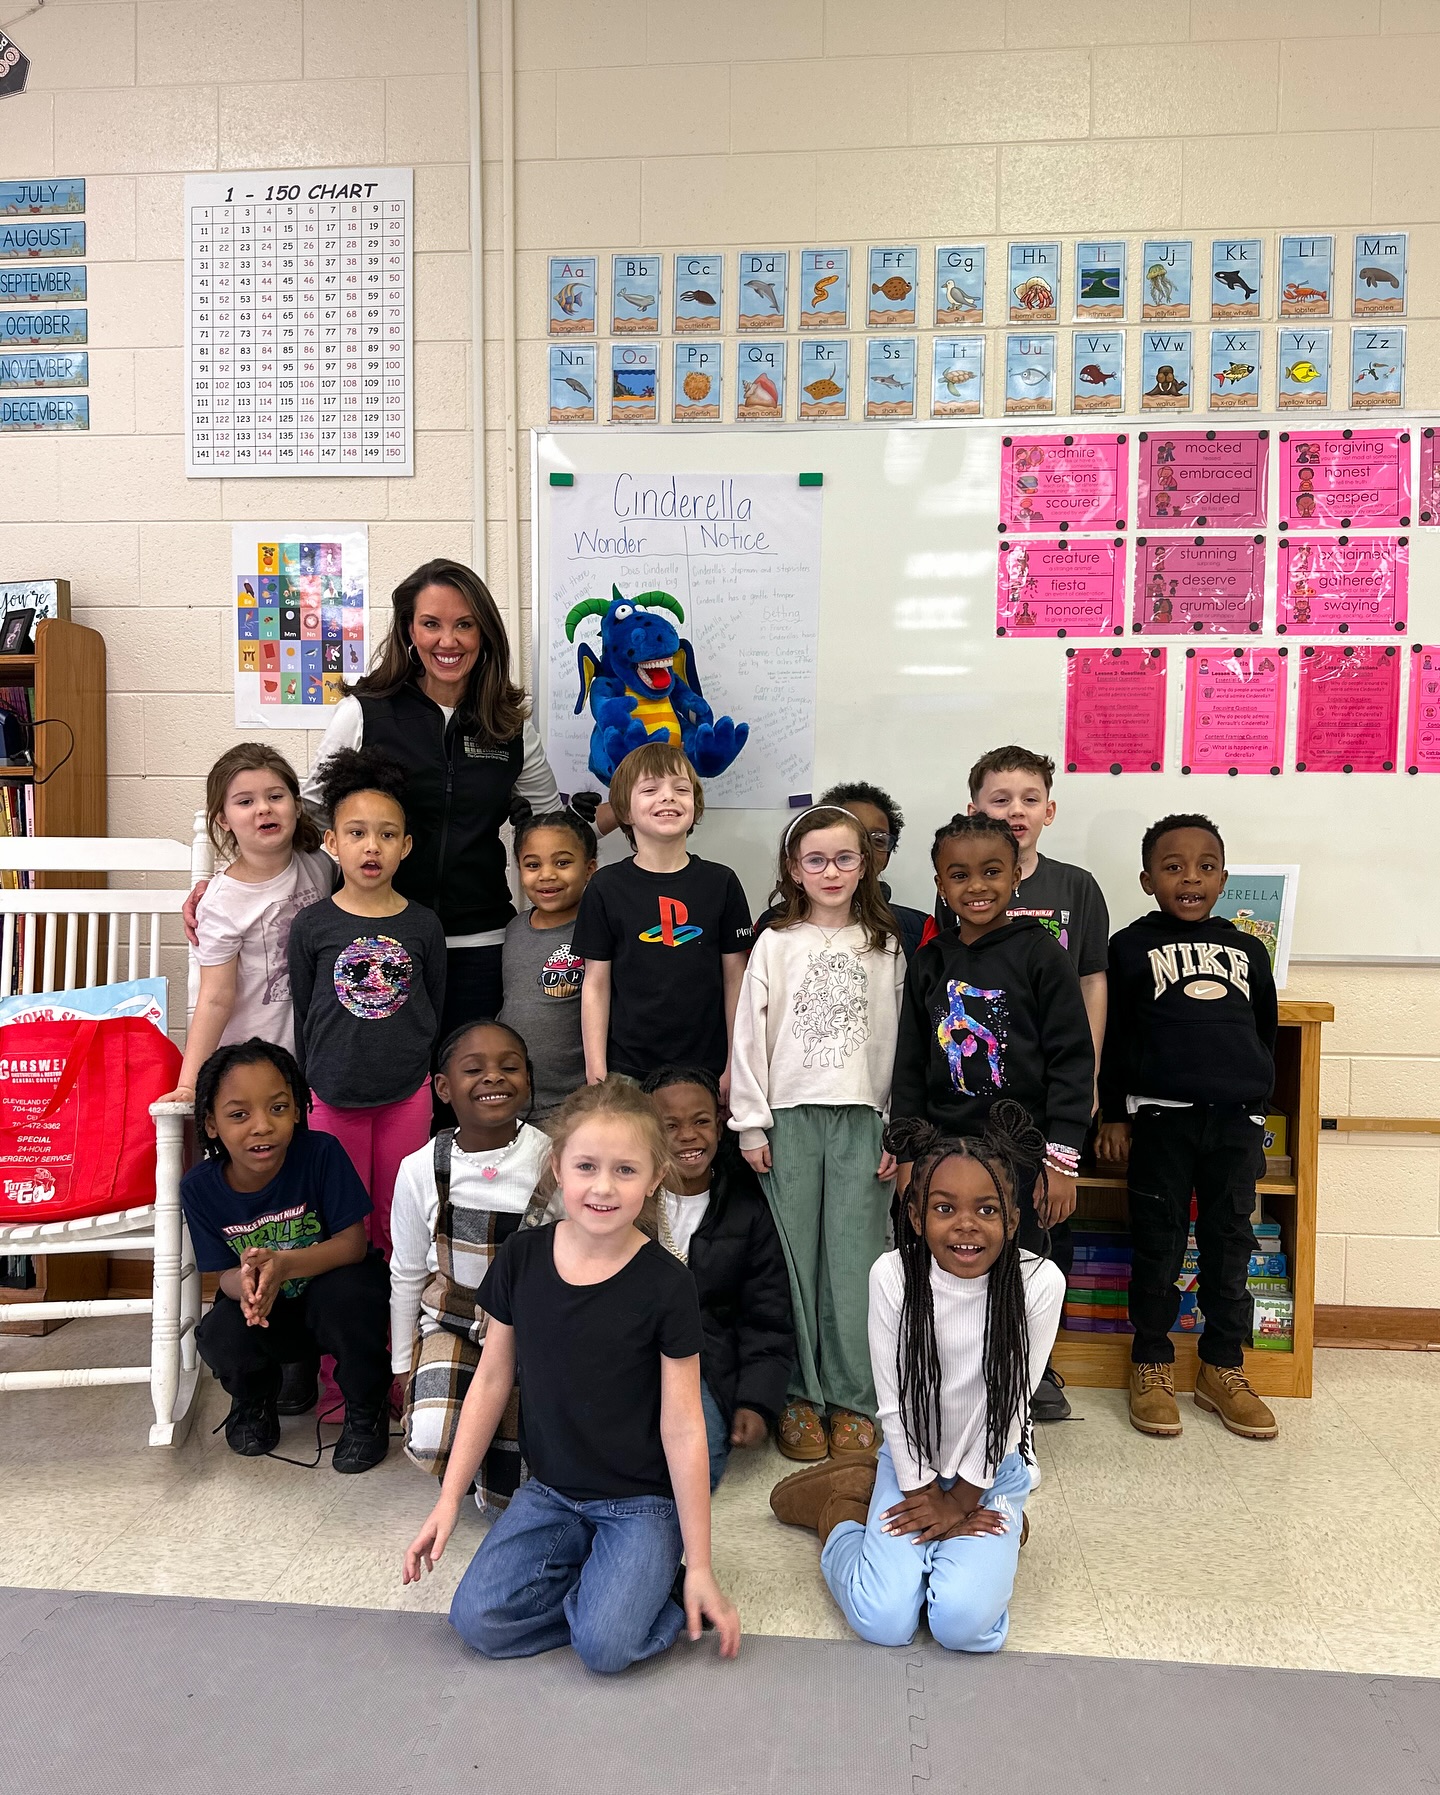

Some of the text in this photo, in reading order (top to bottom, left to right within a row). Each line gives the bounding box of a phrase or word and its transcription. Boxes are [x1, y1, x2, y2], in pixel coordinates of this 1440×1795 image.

[16, 185, 58, 203] JULY
[225, 187, 234, 202] 1
[265, 185, 300, 200] 150
[308, 183, 377, 199] CHART
[3, 228, 72, 247] AUGUST
[0, 272, 71, 292] SEPTEMBER
[6, 315, 70, 335] OCTOBER
[2, 358, 73, 378] NOVEMBER
[4, 402, 74, 421] DECEMBER
[1048, 447, 1094, 459] admire
[1186, 442, 1242, 453] mocked
[1325, 442, 1384, 455] forgiving
[1045, 472, 1097, 483] versions
[1180, 468, 1252, 479] embraced
[1325, 466, 1371, 478] honest
[613, 472, 751, 520] Cinderella
[1046, 497, 1100, 508] scoured
[1186, 493, 1240, 504] scolded
[1327, 491, 1379, 505] gasped
[574, 526, 647, 554] Wonder
[700, 523, 770, 550] Notice
[1043, 554, 1100, 563] creature
[1180, 548, 1237, 561] stunning
[1051, 580, 1086, 591] fiesta
[1182, 574, 1236, 585] deserve
[1046, 604, 1103, 616] honored
[1324, 599, 1379, 613] swaying
[1219, 889, 1279, 900] DERELLA
[736, 925, 753, 938] Play
[1148, 942, 1250, 1002] NIKE
[223, 1205, 305, 1236] TEENAGE MUTANT NINJA
[226, 1212, 322, 1255] URTLES
[1246, 1282, 1286, 1291] AMILIES
[1256, 1300, 1291, 1310] Beginning
